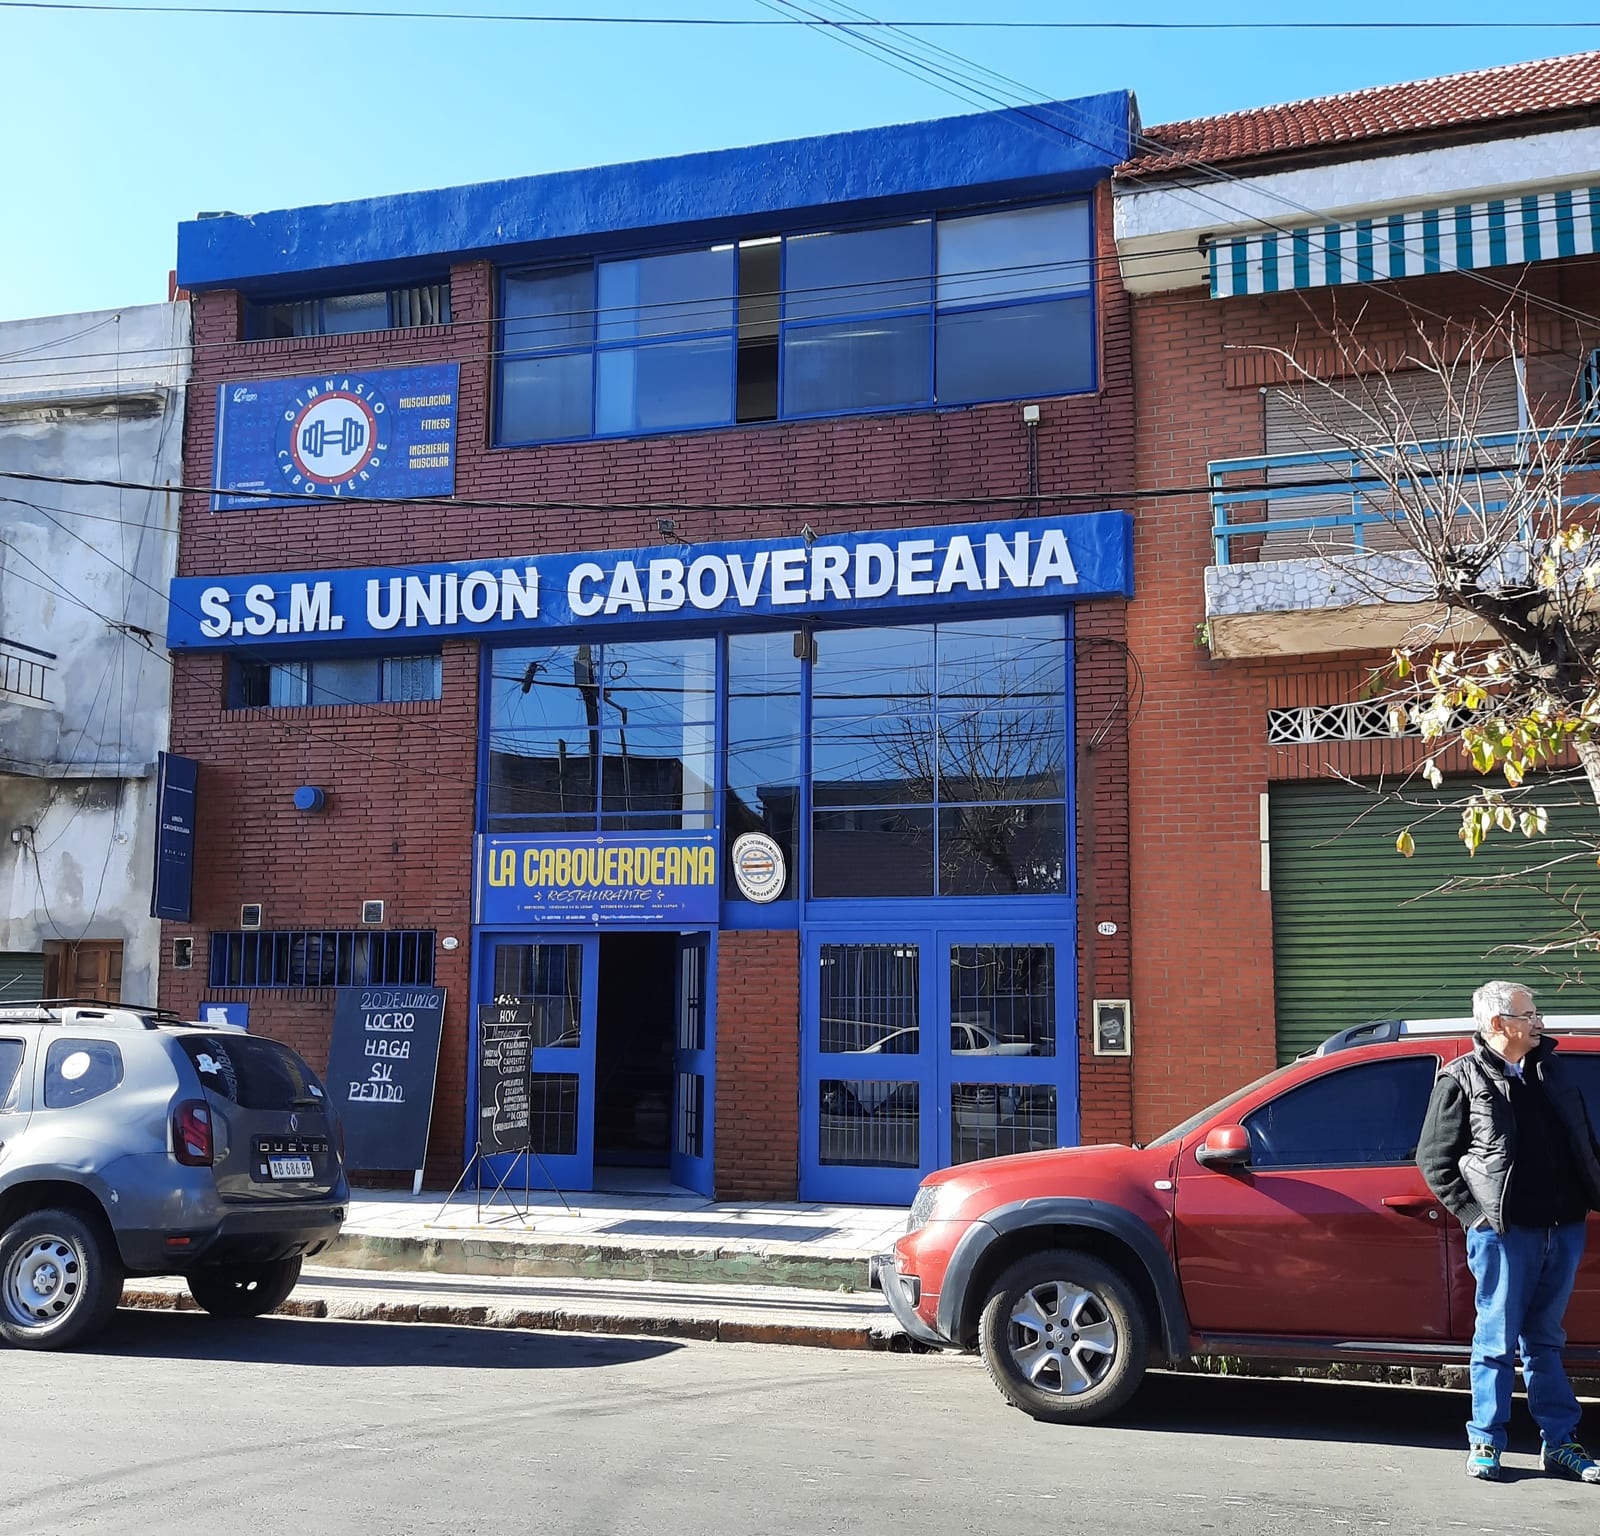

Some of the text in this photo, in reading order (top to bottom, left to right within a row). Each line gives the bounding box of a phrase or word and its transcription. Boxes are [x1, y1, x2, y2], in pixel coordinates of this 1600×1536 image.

[284, 379, 385, 421] GIMNASIO
[399, 392, 451, 409] MUSCULACIÓN
[421, 418, 450, 431] FITNESS
[278, 443, 387, 495] CABO VERDE
[409, 456, 449, 470] MUSCULAR
[200, 529, 1078, 638] S.S.M. UNION CABOVERDEANA
[489, 846, 715, 887] LA CABOVERDEANA
[547, 889, 652, 902] RESTAURANTE
[361, 991, 439, 1009] 20 DE JUNIO
[365, 1012, 415, 1029] LOCRO
[500, 1010, 517, 1022] HOY
[365, 1039, 410, 1058] HAGA
[348, 1082, 404, 1101] PEDIDO
[260, 1143, 329, 1152] DUSTER
[273, 1162, 312, 1175] AB 686 BP
